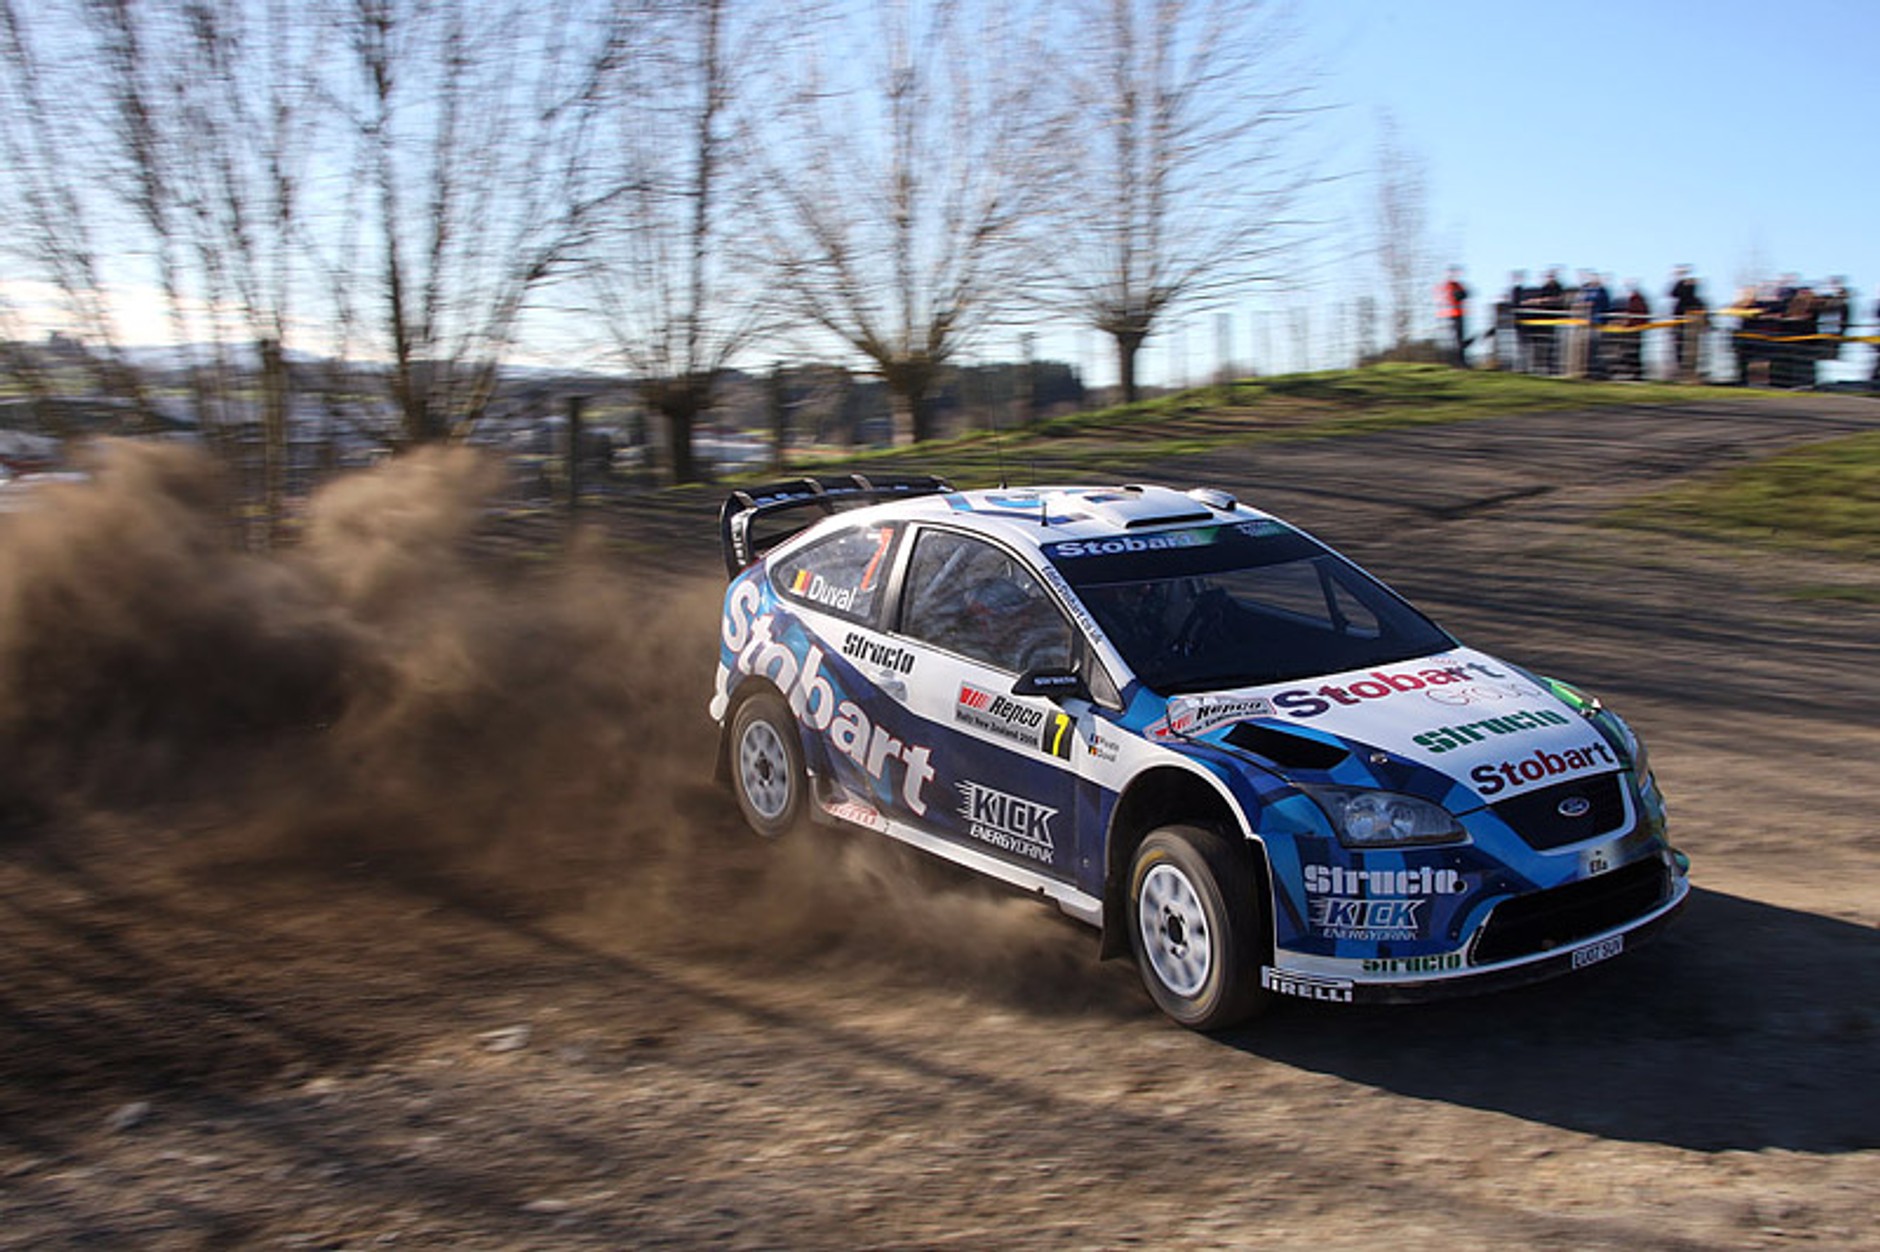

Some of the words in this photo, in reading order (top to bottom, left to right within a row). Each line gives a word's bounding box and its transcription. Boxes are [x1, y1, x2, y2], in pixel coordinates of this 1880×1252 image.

[860, 527, 894, 592] 7
[1056, 534, 1194, 557] Stobart
[808, 575, 857, 612] Duval
[722, 580, 935, 816] Stobart
[989, 695, 1043, 728] Repco
[1272, 662, 1506, 718] Stobart
[1051, 713, 1071, 758] 7
[1471, 742, 1614, 795] Stobart
[1261, 965, 1354, 1003] PIRELLI
